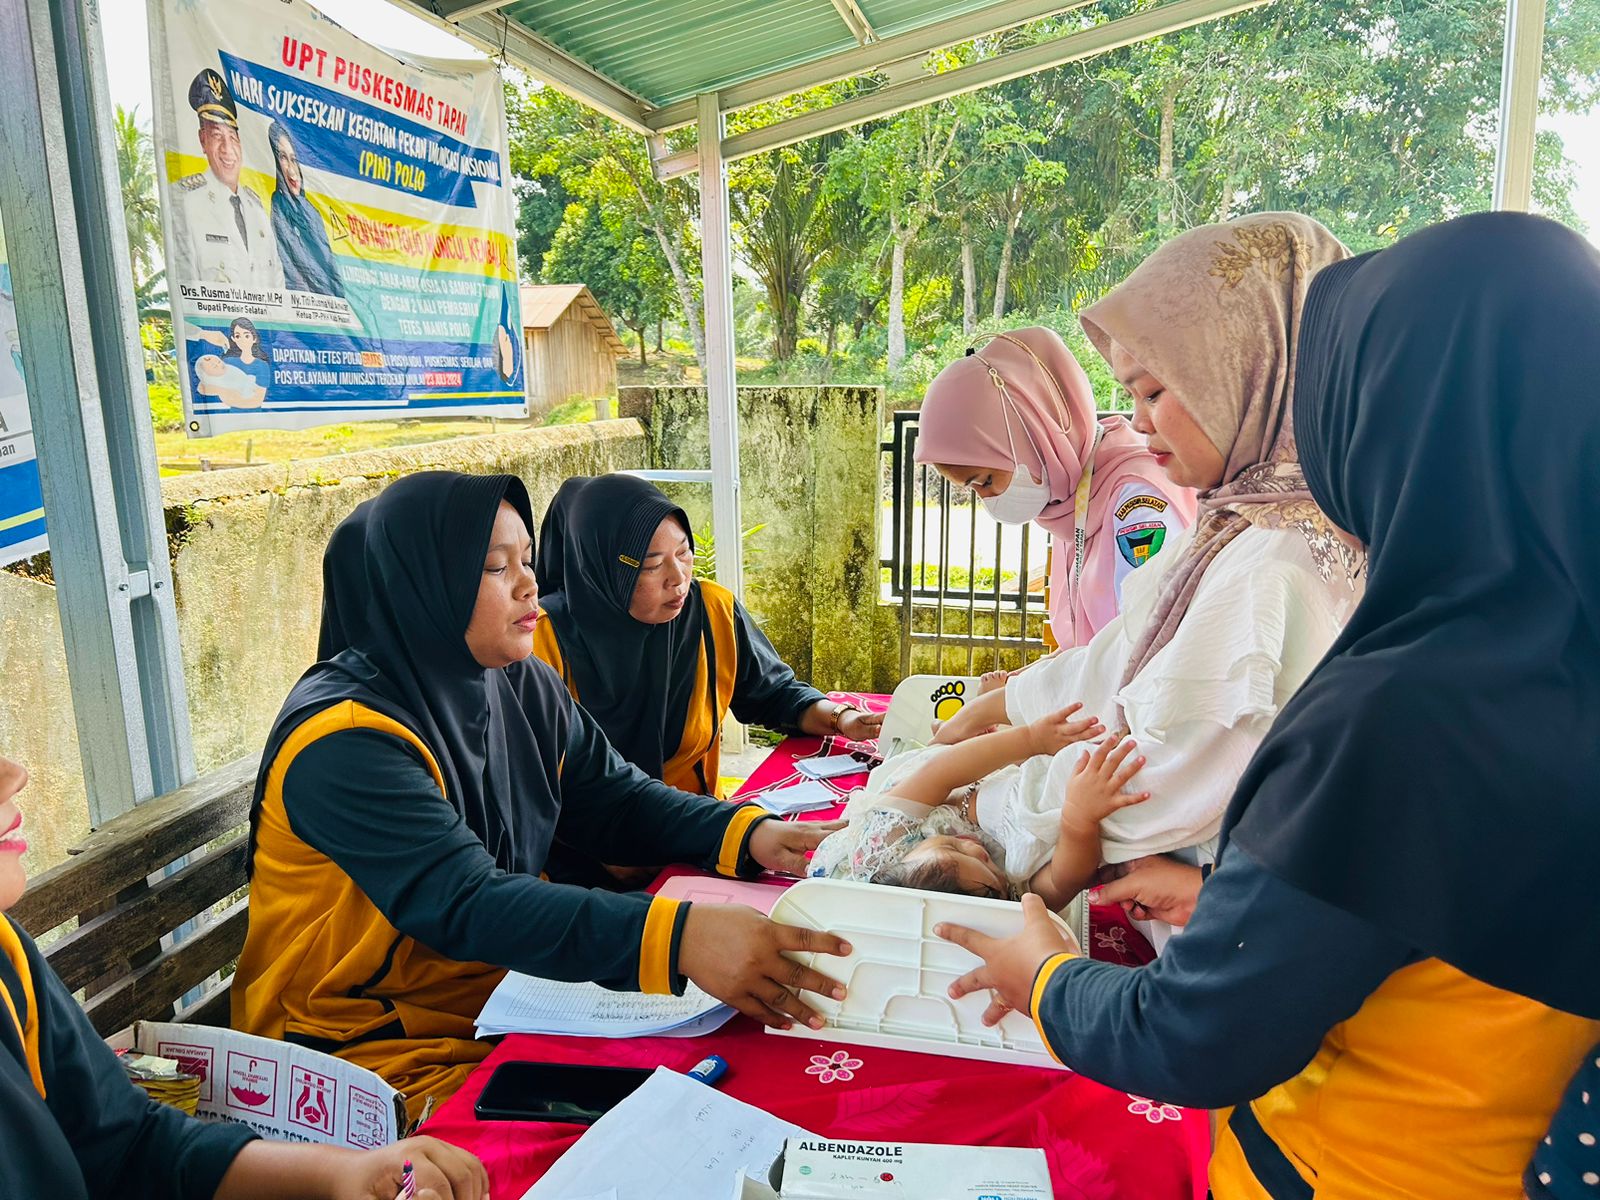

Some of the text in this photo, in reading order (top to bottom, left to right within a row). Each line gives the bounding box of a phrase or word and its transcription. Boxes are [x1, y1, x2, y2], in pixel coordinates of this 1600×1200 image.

[281, 36, 328, 78] UPT
[333, 55, 433, 121] PUSKESMAS
[438, 101, 467, 137] TAPAN
[230, 69, 263, 108] MARI
[267, 84, 346, 132] SUKSESKAN
[348, 111, 396, 150] KEGIATAN
[398, 129, 427, 160] PEKAN
[460, 154, 500, 181] NASIONAL
[359, 150, 426, 193] (PIN) POLIO
[425, 233, 469, 263] MUNCUL
[180, 285, 283, 304] Drs. Rusma Yul Anwar, M.Pd
[290, 294, 302, 307] Ny.
[197, 301, 268, 315] Bupati Pesisir Selatan
[295, 311, 312, 319] Ketua
[398, 319, 471, 337] TETES MANIS POLIO
[272, 347, 316, 364] DAPATKAN
[317, 350, 341, 365] TETES
[342, 351, 362, 365] POLIO
[274, 369, 293, 385] POS
[293, 370, 338, 385] PELAYANAN
[339, 371, 376, 385] IMUNISASI
[447, 373, 462, 385] 2024
[798, 1141, 903, 1157] ALBENDAZOLE
[856, 1155, 882, 1163] KUNYAH
